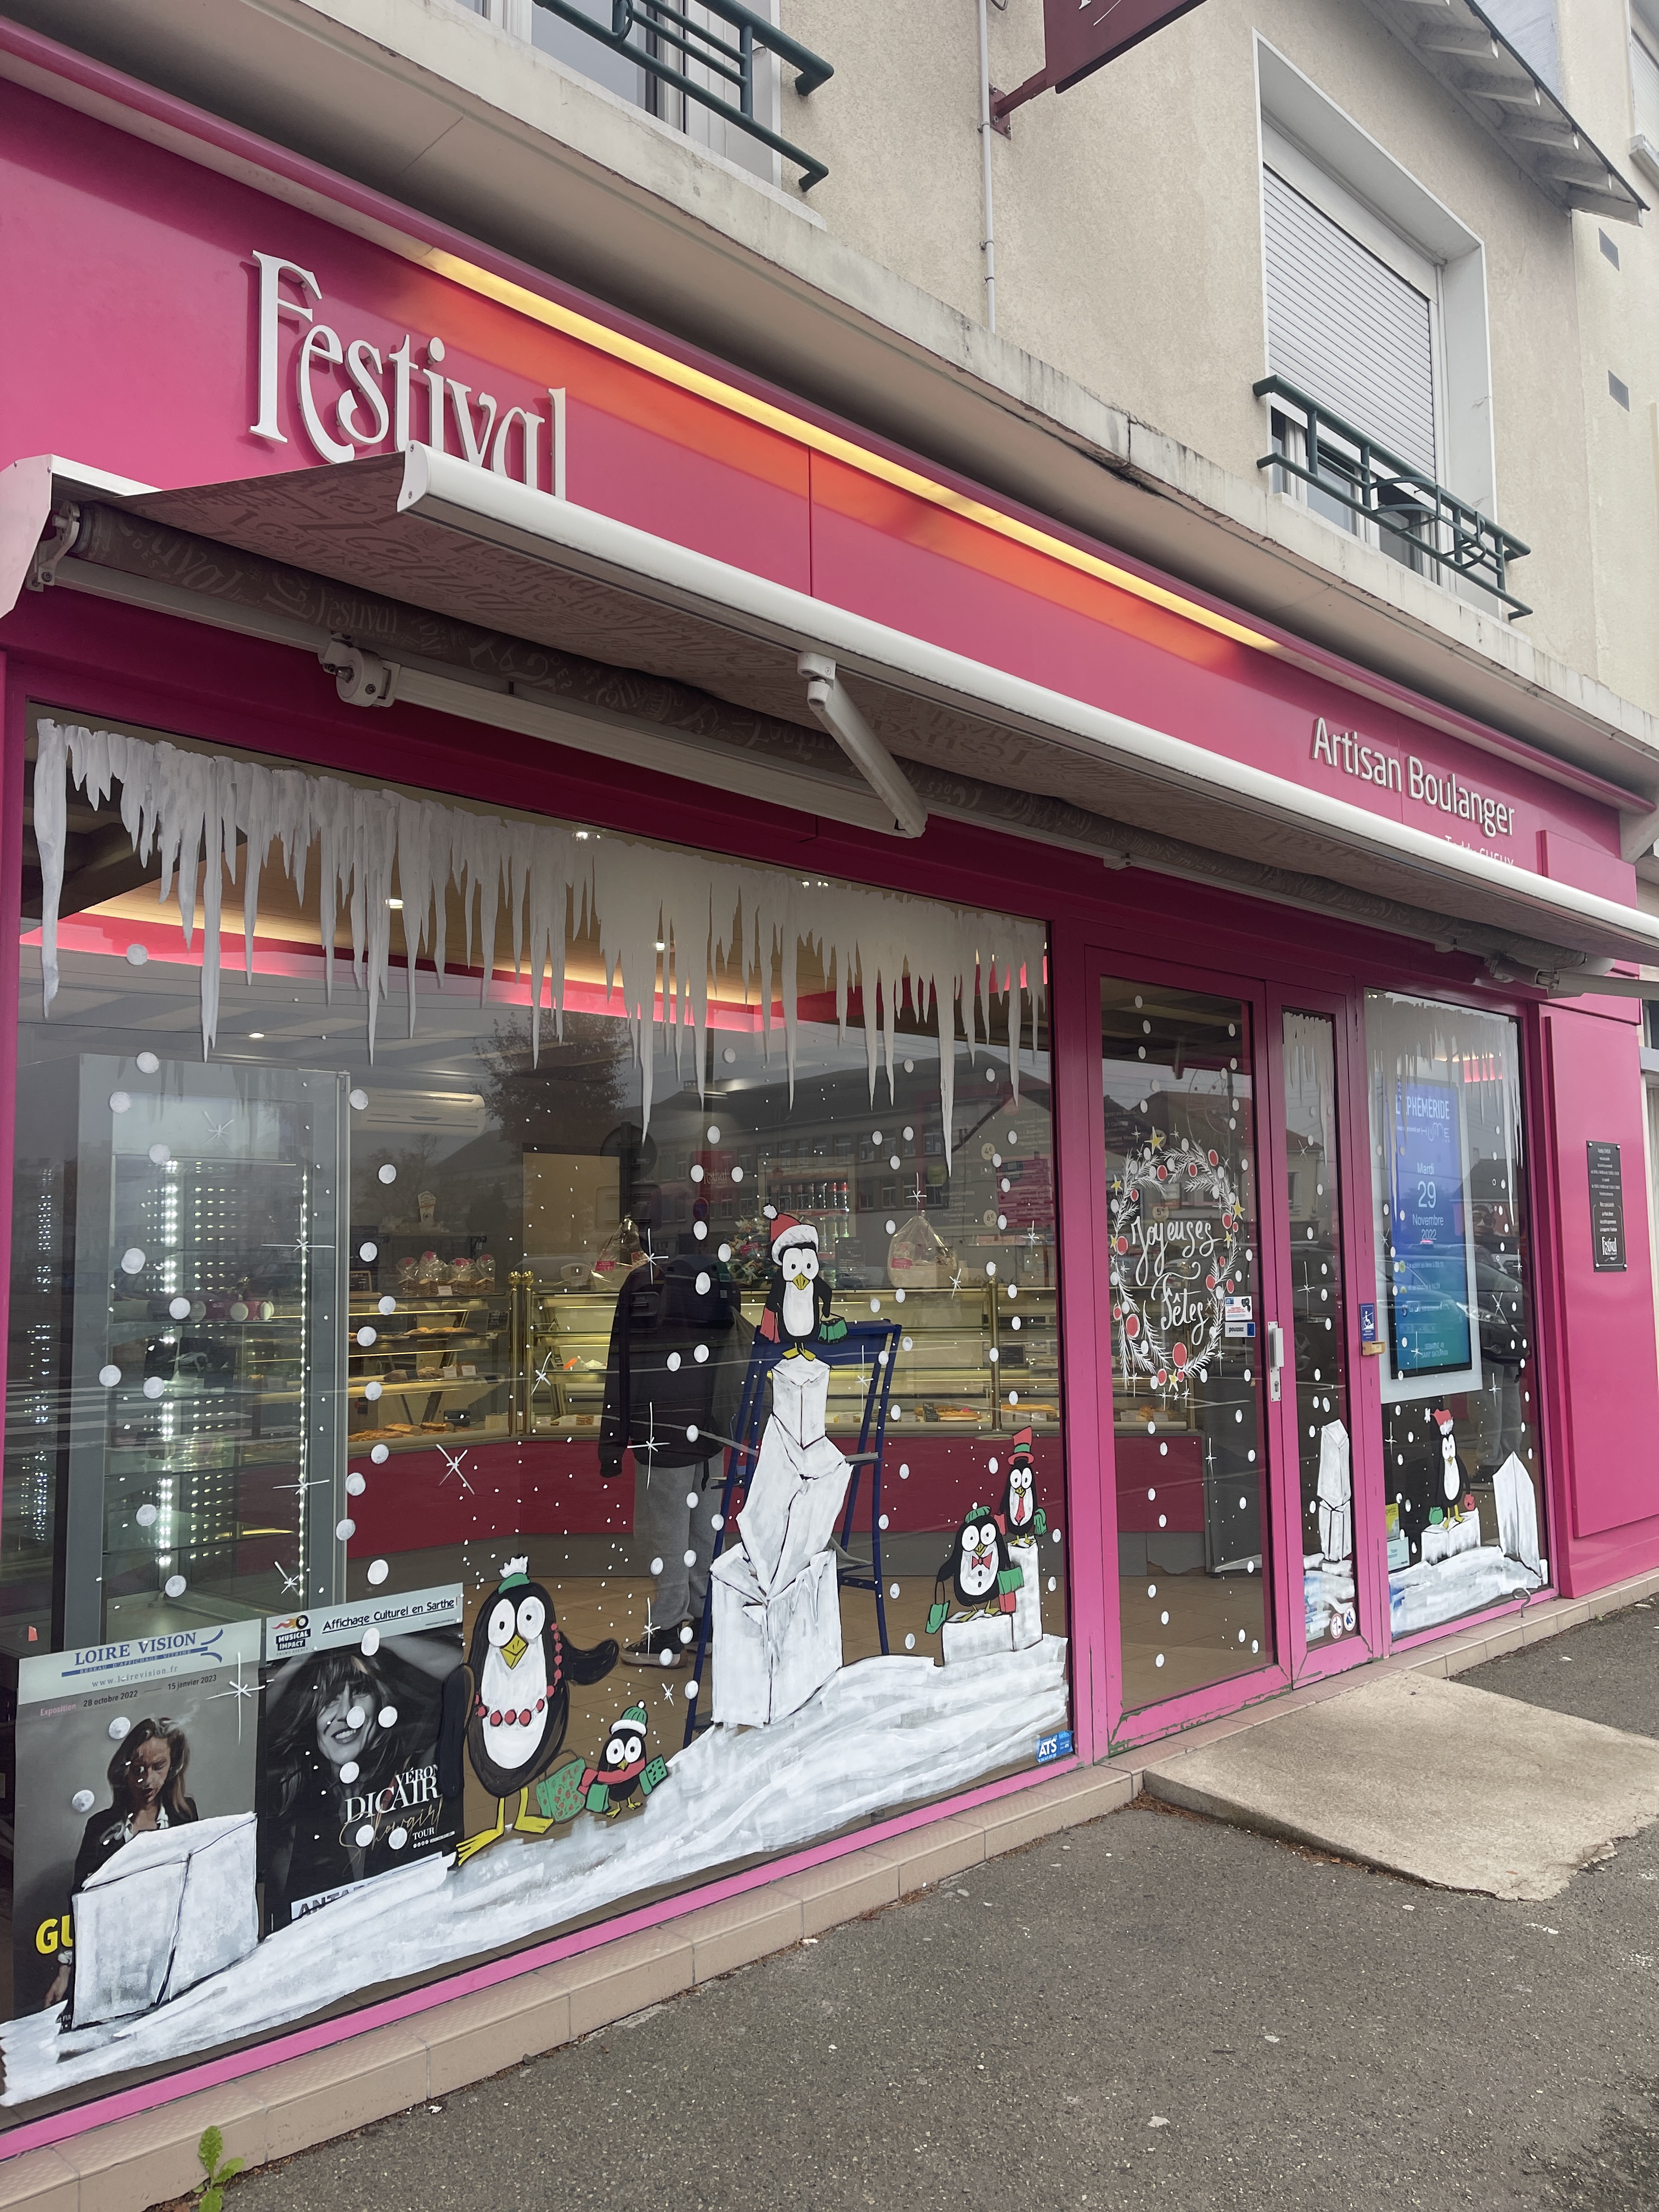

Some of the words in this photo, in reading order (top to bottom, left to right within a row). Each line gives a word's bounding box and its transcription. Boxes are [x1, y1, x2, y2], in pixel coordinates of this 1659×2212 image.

[248, 250, 566, 500] Festival
[1312, 717, 1402, 792] Artisan
[1406, 755, 1515, 838] Boulanger
[1417, 1162, 1435, 1175] Mardi
[1418, 1181, 1437, 1209] 29
[1412, 1214, 1444, 1226] Novembre
[1421, 1228, 1437, 1241] 2022
[1131, 1216, 1223, 1286] Joyeuses
[1151, 1262, 1210, 1346] Fêtes
[322, 1615, 370, 1632] Affichage
[374, 1606, 409, 1622] Culturel
[411, 1605, 423, 1613] en
[426, 1599, 455, 1612] Sarthe
[278, 1630, 309, 1643] MUSICAL
[279, 1639, 304, 1650] IMPACT
[75, 1644, 131, 1666] LOIRE
[138, 1632, 197, 1655] VISION
[92, 1665, 178, 1688] www.loirevision.fr
[94, 1694, 119, 1706] octobre
[120, 1690, 138, 1701] 2022
[167, 1683, 176, 1691] 15
[176, 1679, 200, 1691] janvier
[201, 1674, 217, 1685] 2023
[40, 1702, 77, 1717] Exposition
[1039, 1739, 1057, 1758] ATS
[412, 1827, 435, 1841] TOUR
